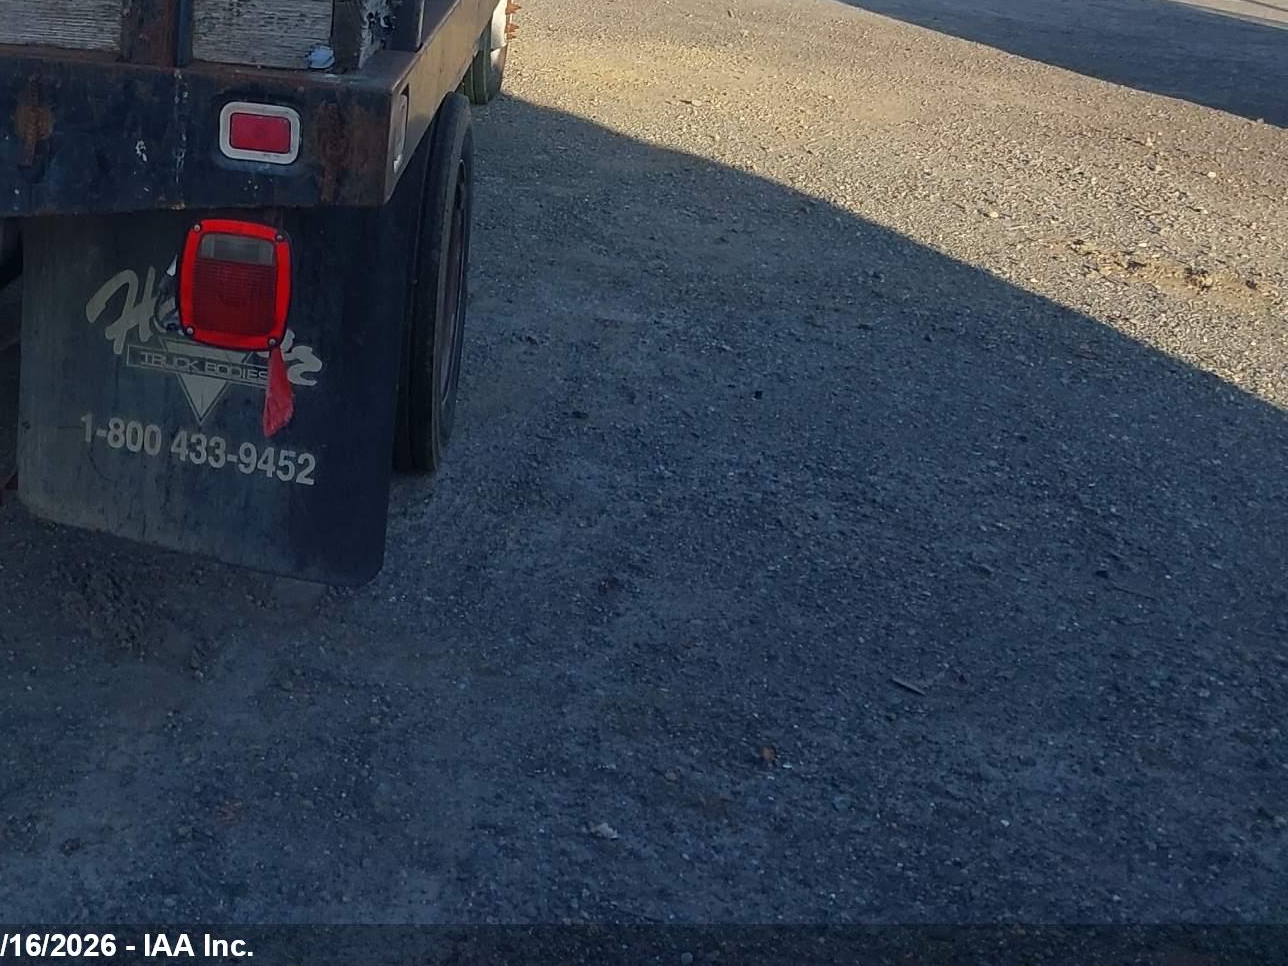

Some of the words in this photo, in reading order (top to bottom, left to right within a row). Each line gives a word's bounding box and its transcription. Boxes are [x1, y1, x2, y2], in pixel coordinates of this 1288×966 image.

[140, 351, 201, 373] TRUCK
[80, 413, 162, 457] 1-800
[170, 430, 316, 485] 433-9452
